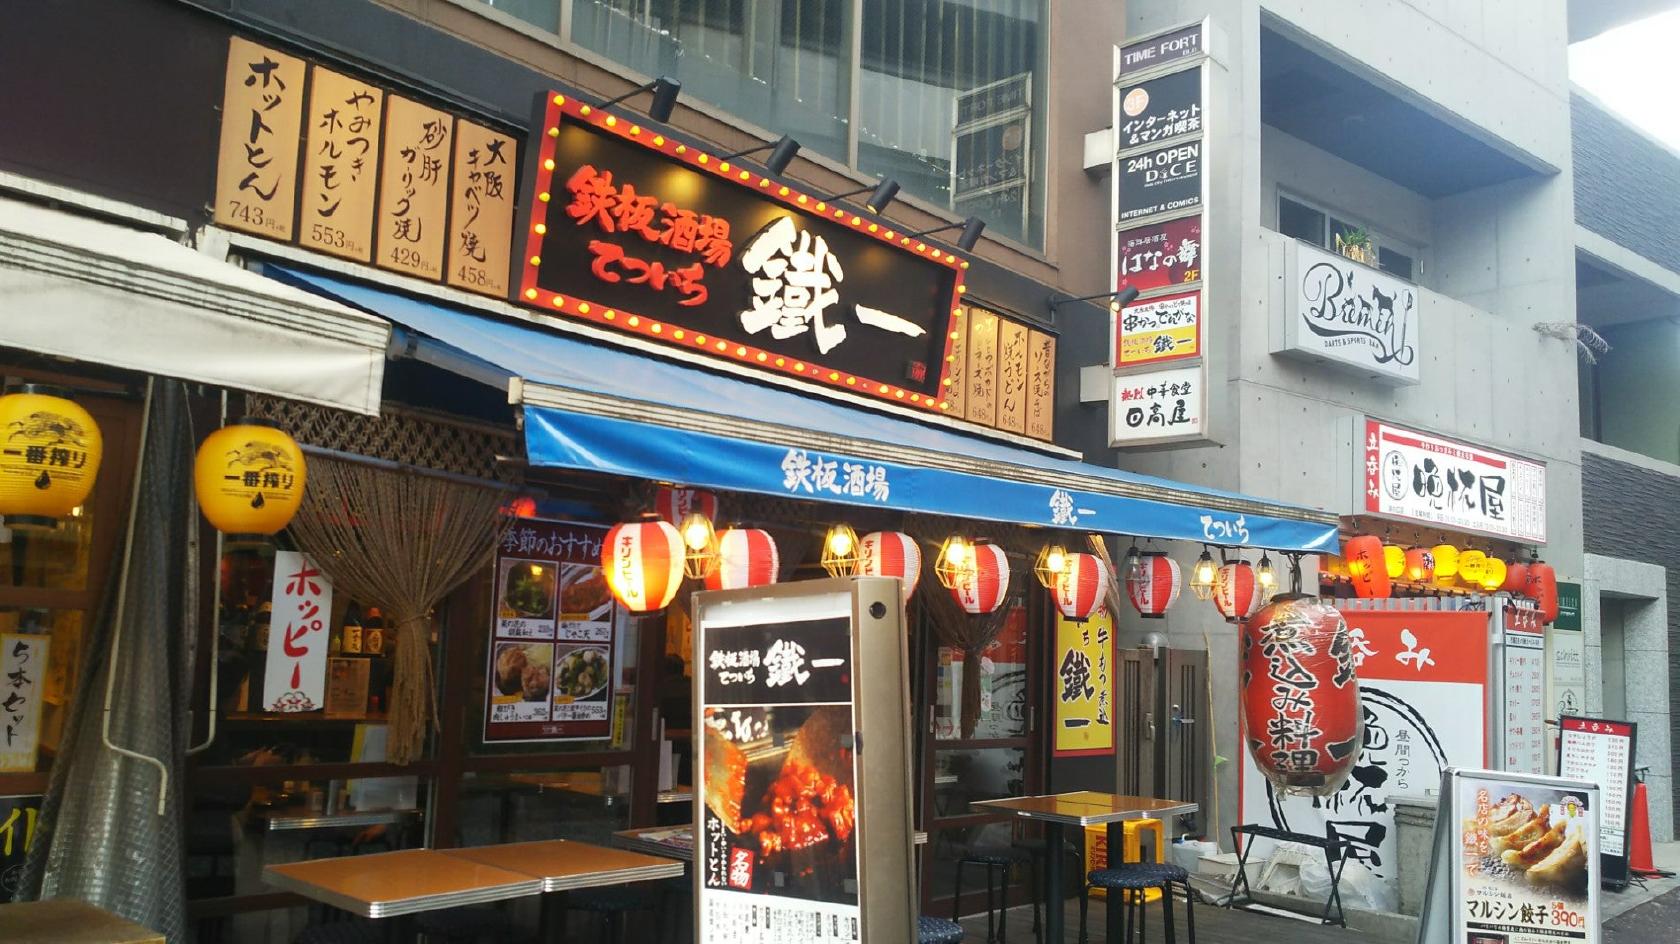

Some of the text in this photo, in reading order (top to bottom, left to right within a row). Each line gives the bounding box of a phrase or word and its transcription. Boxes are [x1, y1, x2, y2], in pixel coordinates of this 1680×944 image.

[1124, 33, 1199, 65] TIME FORT
[239, 56, 285, 200] ホットとん
[1123, 104, 1200, 133] インターネット
[317, 109, 343, 217] ホルモン
[418, 119, 448, 187] 砂肝
[483, 139, 506, 200] 大阪
[1127, 144, 1199, 173] 24h OPEN
[391, 146, 423, 243] ガーリック焼
[460, 149, 486, 262] キャベツ焼
[1121, 205, 1158, 219] INTERNET
[1167, 196, 1199, 210] COMICS
[566, 164, 733, 268] 鉄板酒場
[587, 240, 709, 307] てついち
[1122, 239, 1200, 275] はなの舞
[1184, 269, 1199, 282] 2F
[1123, 307, 1195, 332] 串かつでんがな
[1303, 262, 1413, 365] Bremen
[1324, 340, 1342, 348] DARTS
[1347, 337, 1367, 346] SPORTS
[1126, 399, 1190, 427] 日高屋
[4, 445, 87, 469] 一番搾り
[780, 447, 890, 501] 鉄板酒場
[1366, 432, 1380, 498] 立呑み
[224, 470, 294, 489] 一番搾り
[1413, 457, 1505, 521] 晩杯屋
[503, 527, 603, 560] 季節のおすすめ
[1200, 514, 1250, 544] てついち
[1221, 568, 1232, 607] キリンビール
[283, 559, 323, 690] ホッピー
[709, 650, 760, 670] 鉄板酒場
[718, 669, 756, 686] てついち
[1259, 613, 1323, 773] 煮込み料理
[1395, 730, 1412, 790] 昼間っから
[708, 817, 721, 887] ホットとん
[730, 851, 752, 888] 名物
[1466, 899, 1549, 925] マルシン餃子
[1551, 910, 1585, 928] 390円
